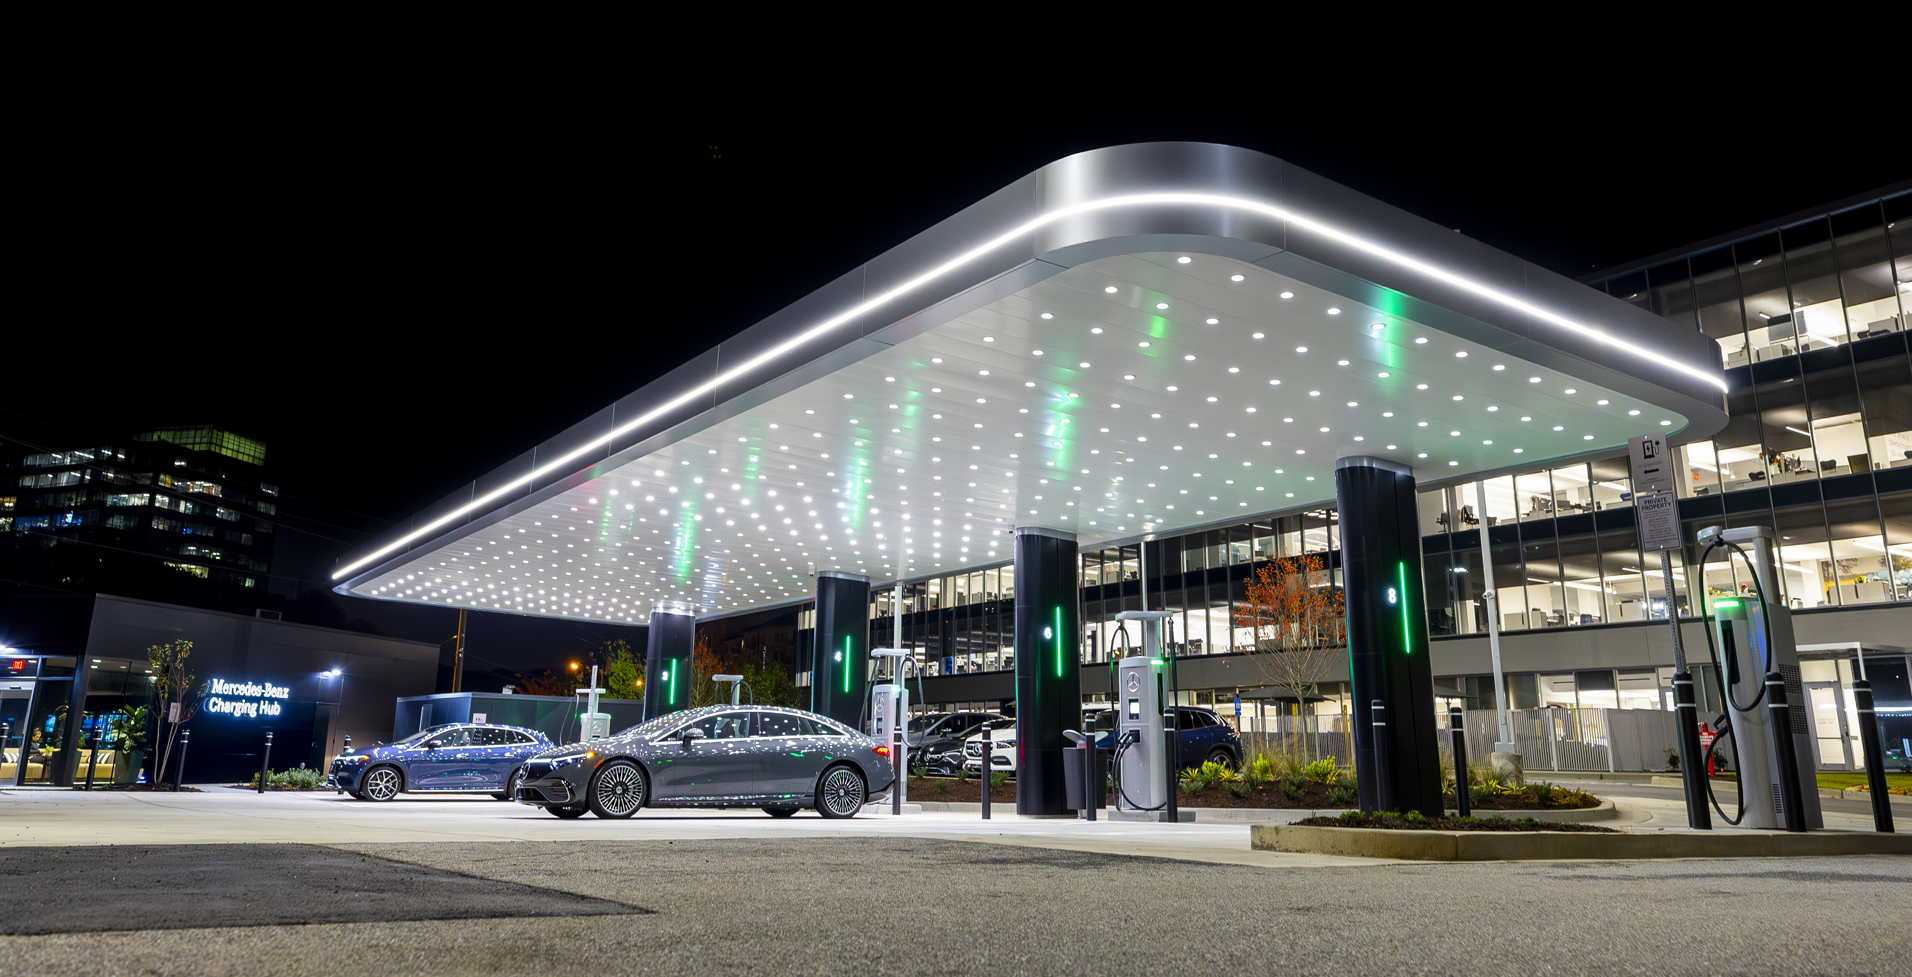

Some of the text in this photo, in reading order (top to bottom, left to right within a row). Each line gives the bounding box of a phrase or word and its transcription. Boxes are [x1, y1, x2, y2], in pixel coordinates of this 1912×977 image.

[1641, 501, 1671, 511] PROPERTY
[1388, 587, 1396, 604] 8
[1044, 626, 1051, 639] 6
[834, 651, 842, 661] 4
[662, 671, 669, 681] 2
[211, 678, 290, 699] Mercedes-Benz
[208, 696, 281, 718] Charging Hub
